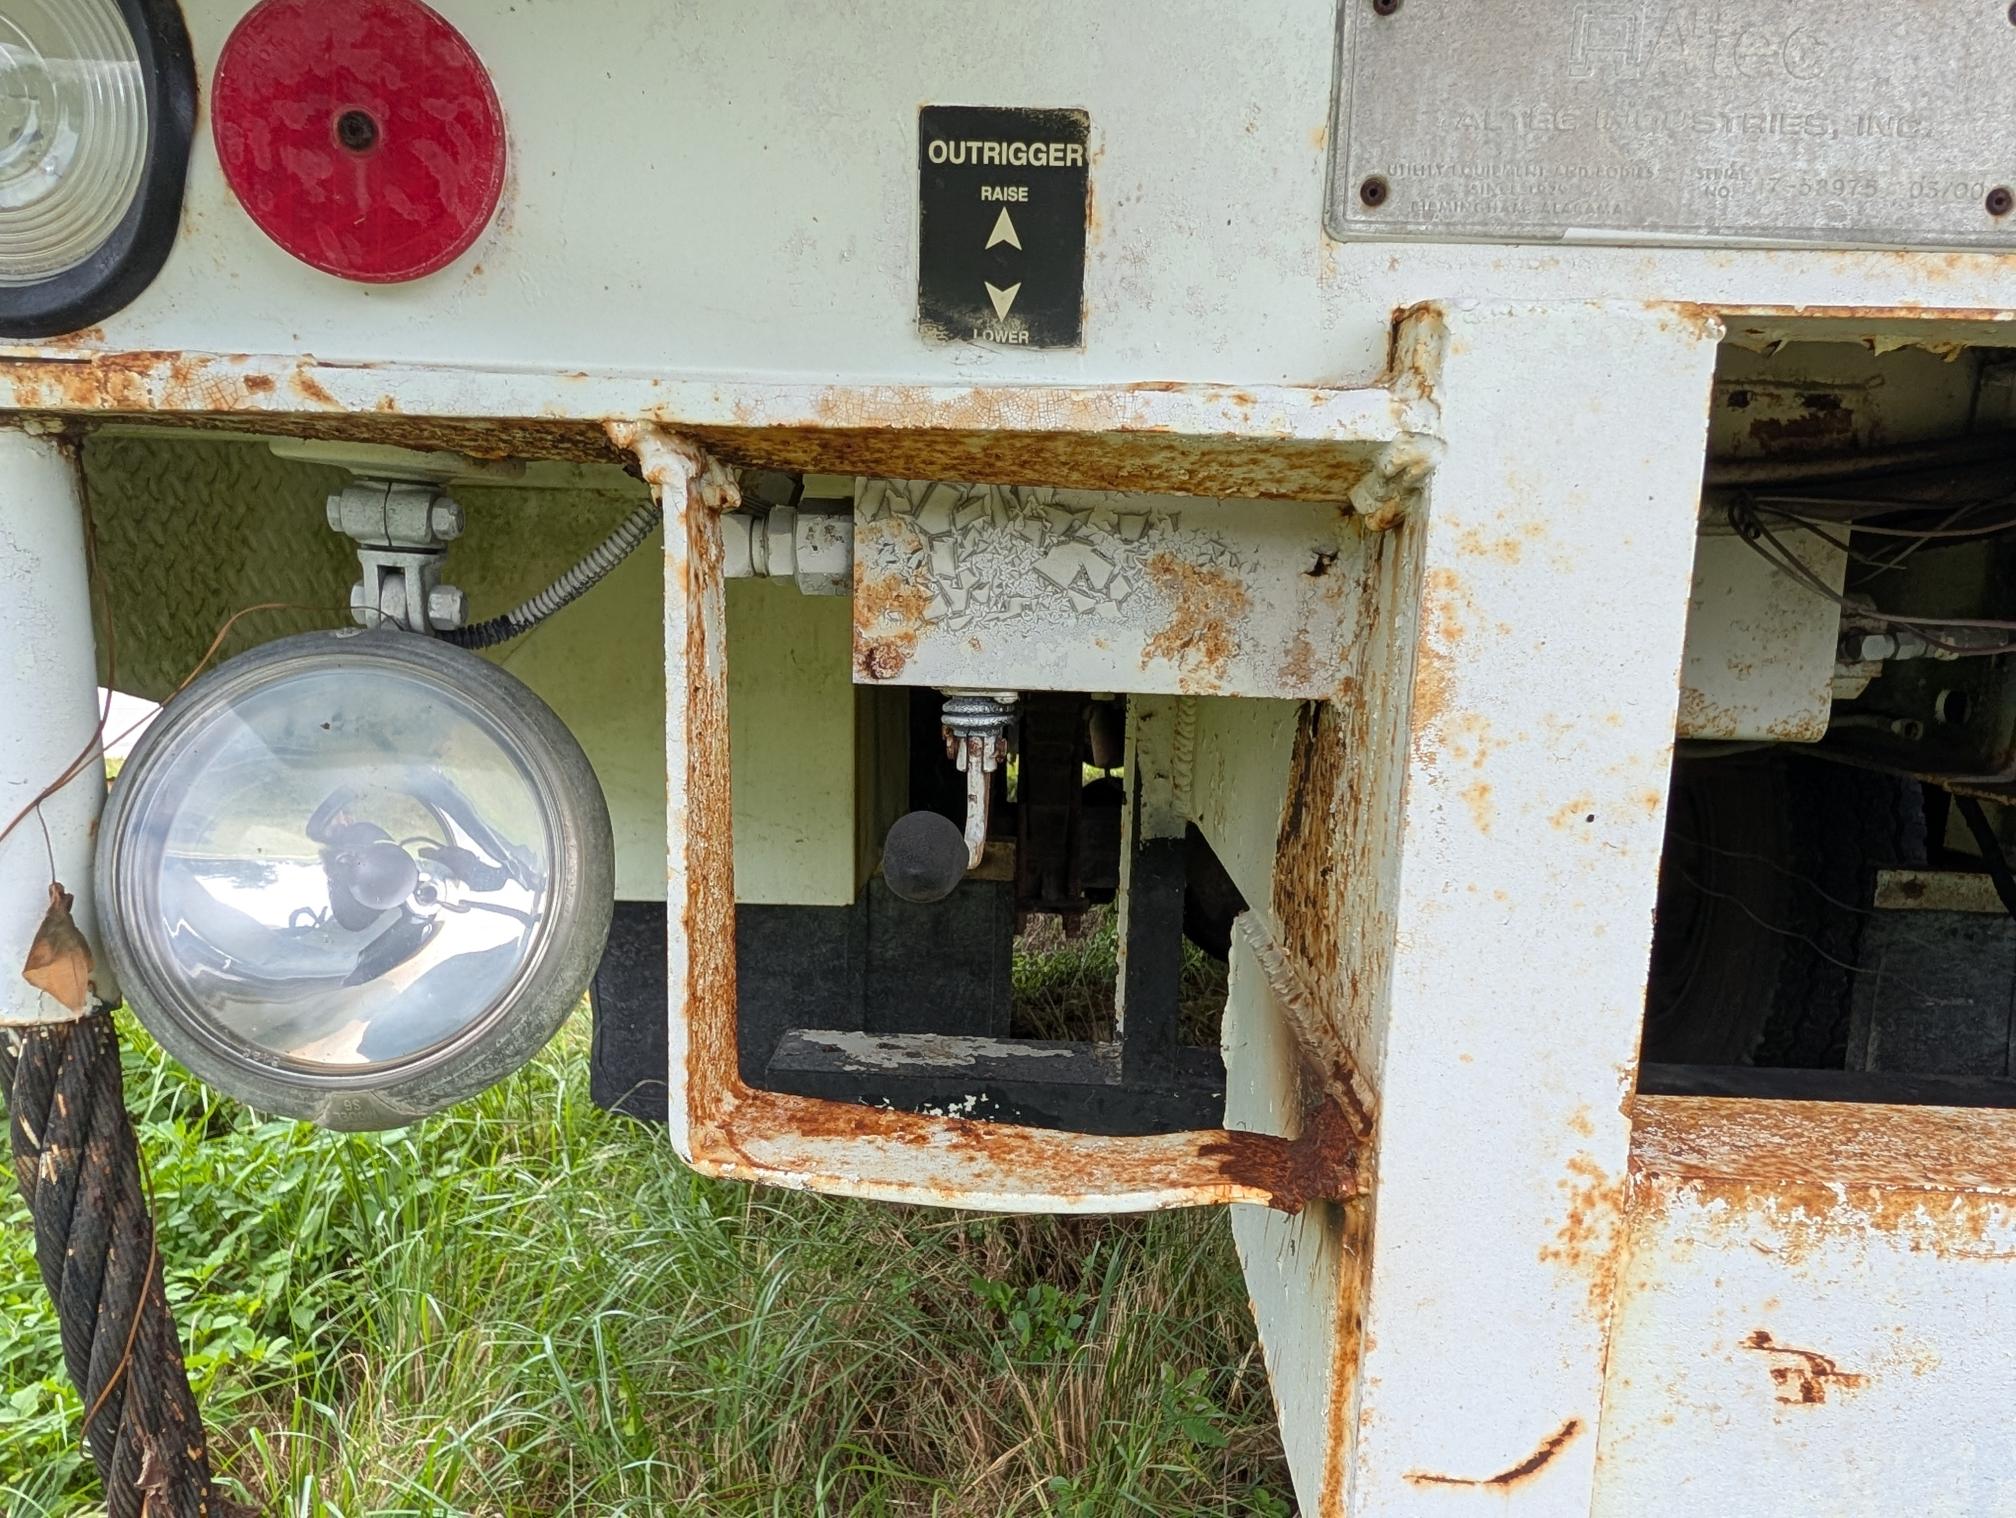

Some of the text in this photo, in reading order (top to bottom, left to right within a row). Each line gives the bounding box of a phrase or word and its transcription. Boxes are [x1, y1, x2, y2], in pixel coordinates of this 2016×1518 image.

[928, 139, 1083, 167] OUTRIGGER
[981, 186, 1029, 202] RAISE
[973, 327, 1030, 344] LOWER
